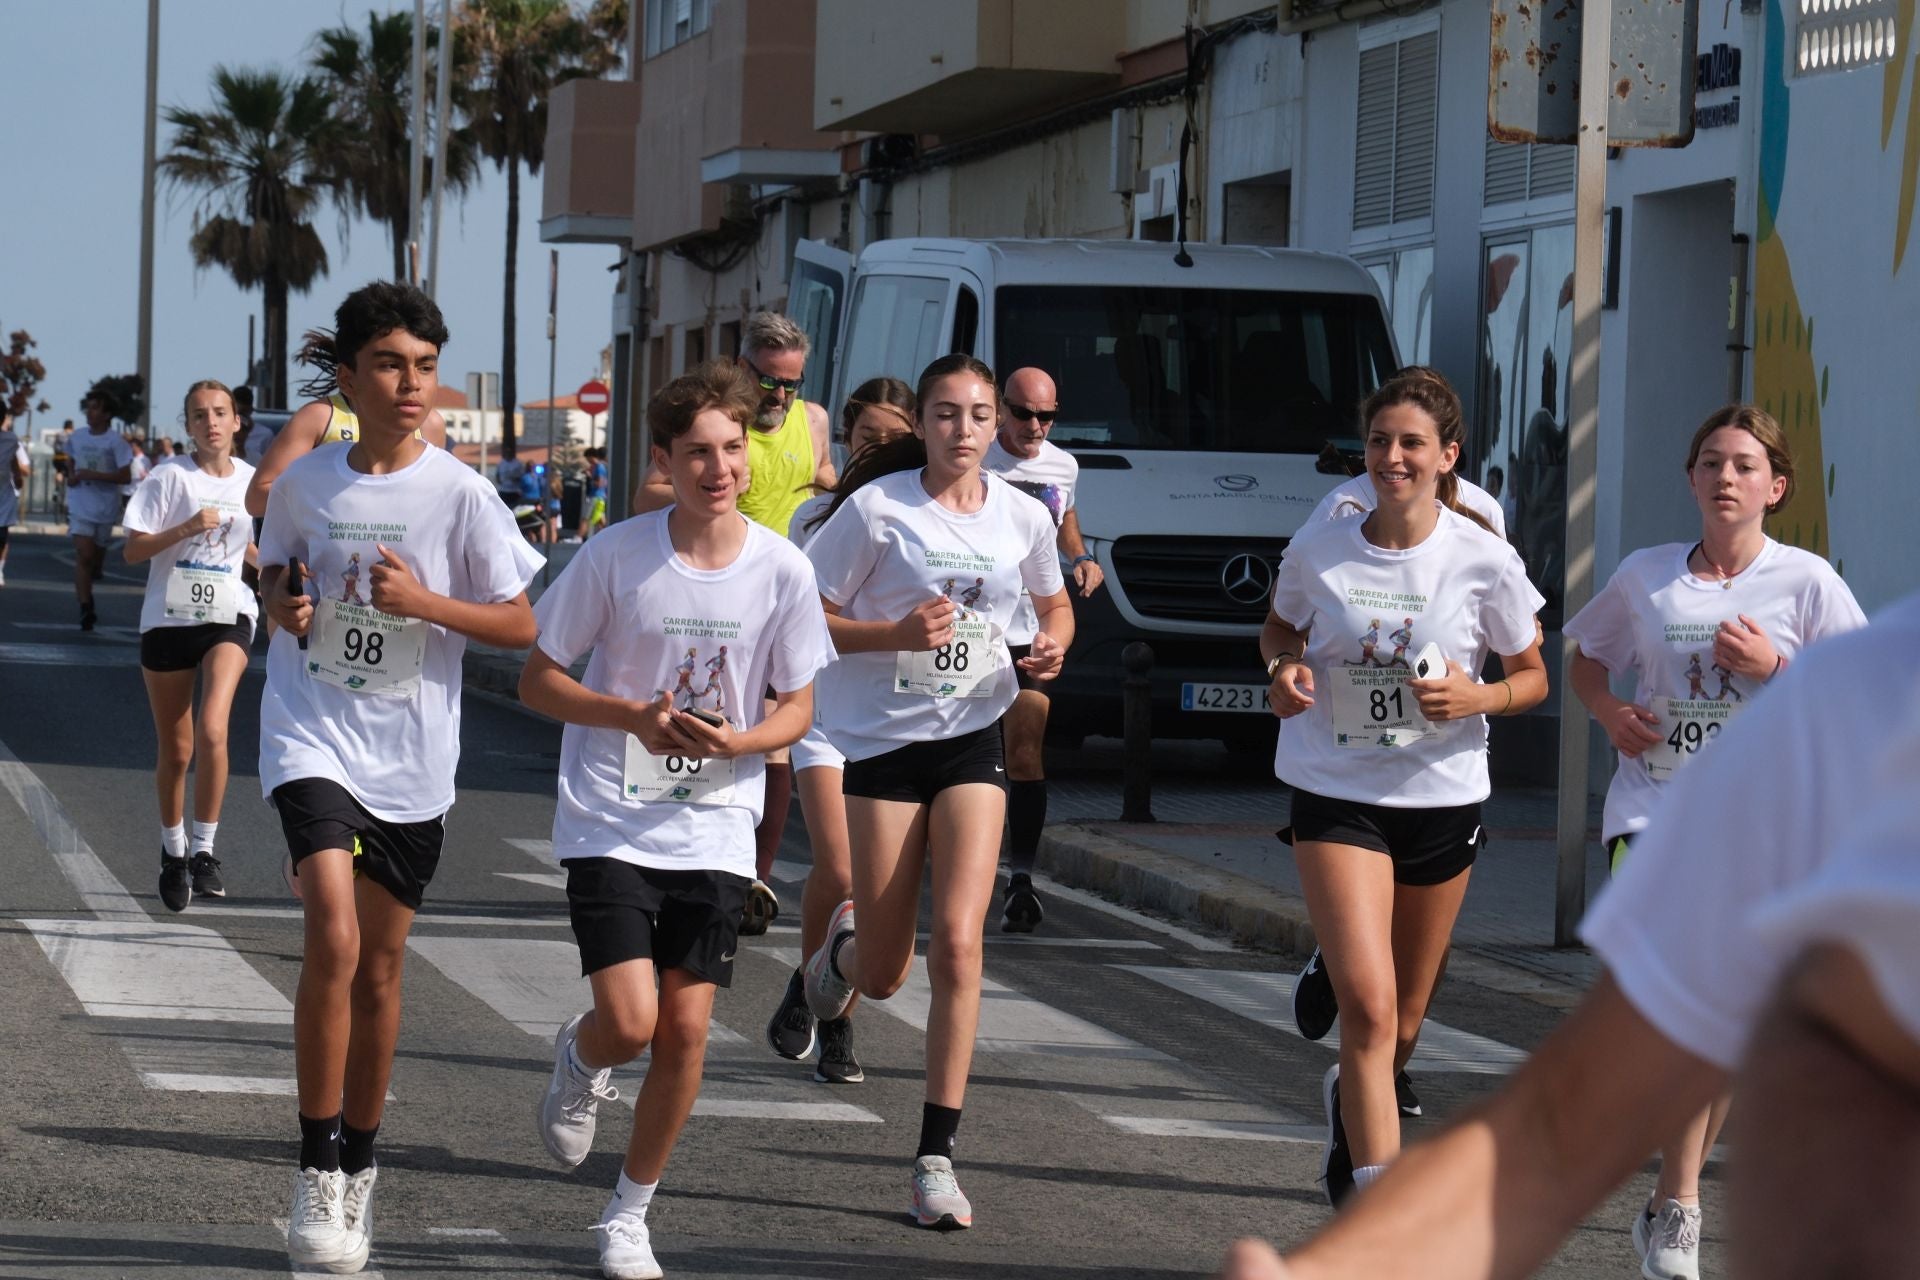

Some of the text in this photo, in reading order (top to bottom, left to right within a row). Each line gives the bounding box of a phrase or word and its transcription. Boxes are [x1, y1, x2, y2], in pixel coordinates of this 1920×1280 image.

[1169, 493, 1211, 501] SANTA
[1259, 494, 1282, 502] DEL
[1285, 495, 1314, 503] MAR
[328, 521, 407, 532] CARRERA URBANA
[328, 532, 403, 542] SAN FELIPE NERI
[924, 550, 996, 563] CARRERA URBANA
[925, 559, 993, 572] SAN FELIPE NERI
[191, 583, 215, 604] 99
[1348, 588, 1428, 602] CARRERA URBANA
[334, 602, 370, 618] CARRERA
[1348, 597, 1423, 612] SAN FELIPE NERI
[334, 612, 349, 622] SAN
[351, 616, 380, 629] FELIPE
[663, 617, 742, 629] CARRERA URBANA
[958, 622, 986, 630] URBANA
[664, 627, 738, 639] SAN FELIPE NERI
[1664, 623, 1705, 632] CARRERA
[1665, 633, 1683, 642] SAN
[344, 628, 384, 665] 98
[935, 641, 969, 672] 88
[1348, 669, 1384, 677] CARRERA
[1351, 678, 1367, 686] SAN
[1368, 676, 1395, 686] FELIPE
[1198, 687, 1253, 708] 4223
[1370, 687, 1404, 721] 81
[1707, 711, 1729, 719] NERI
